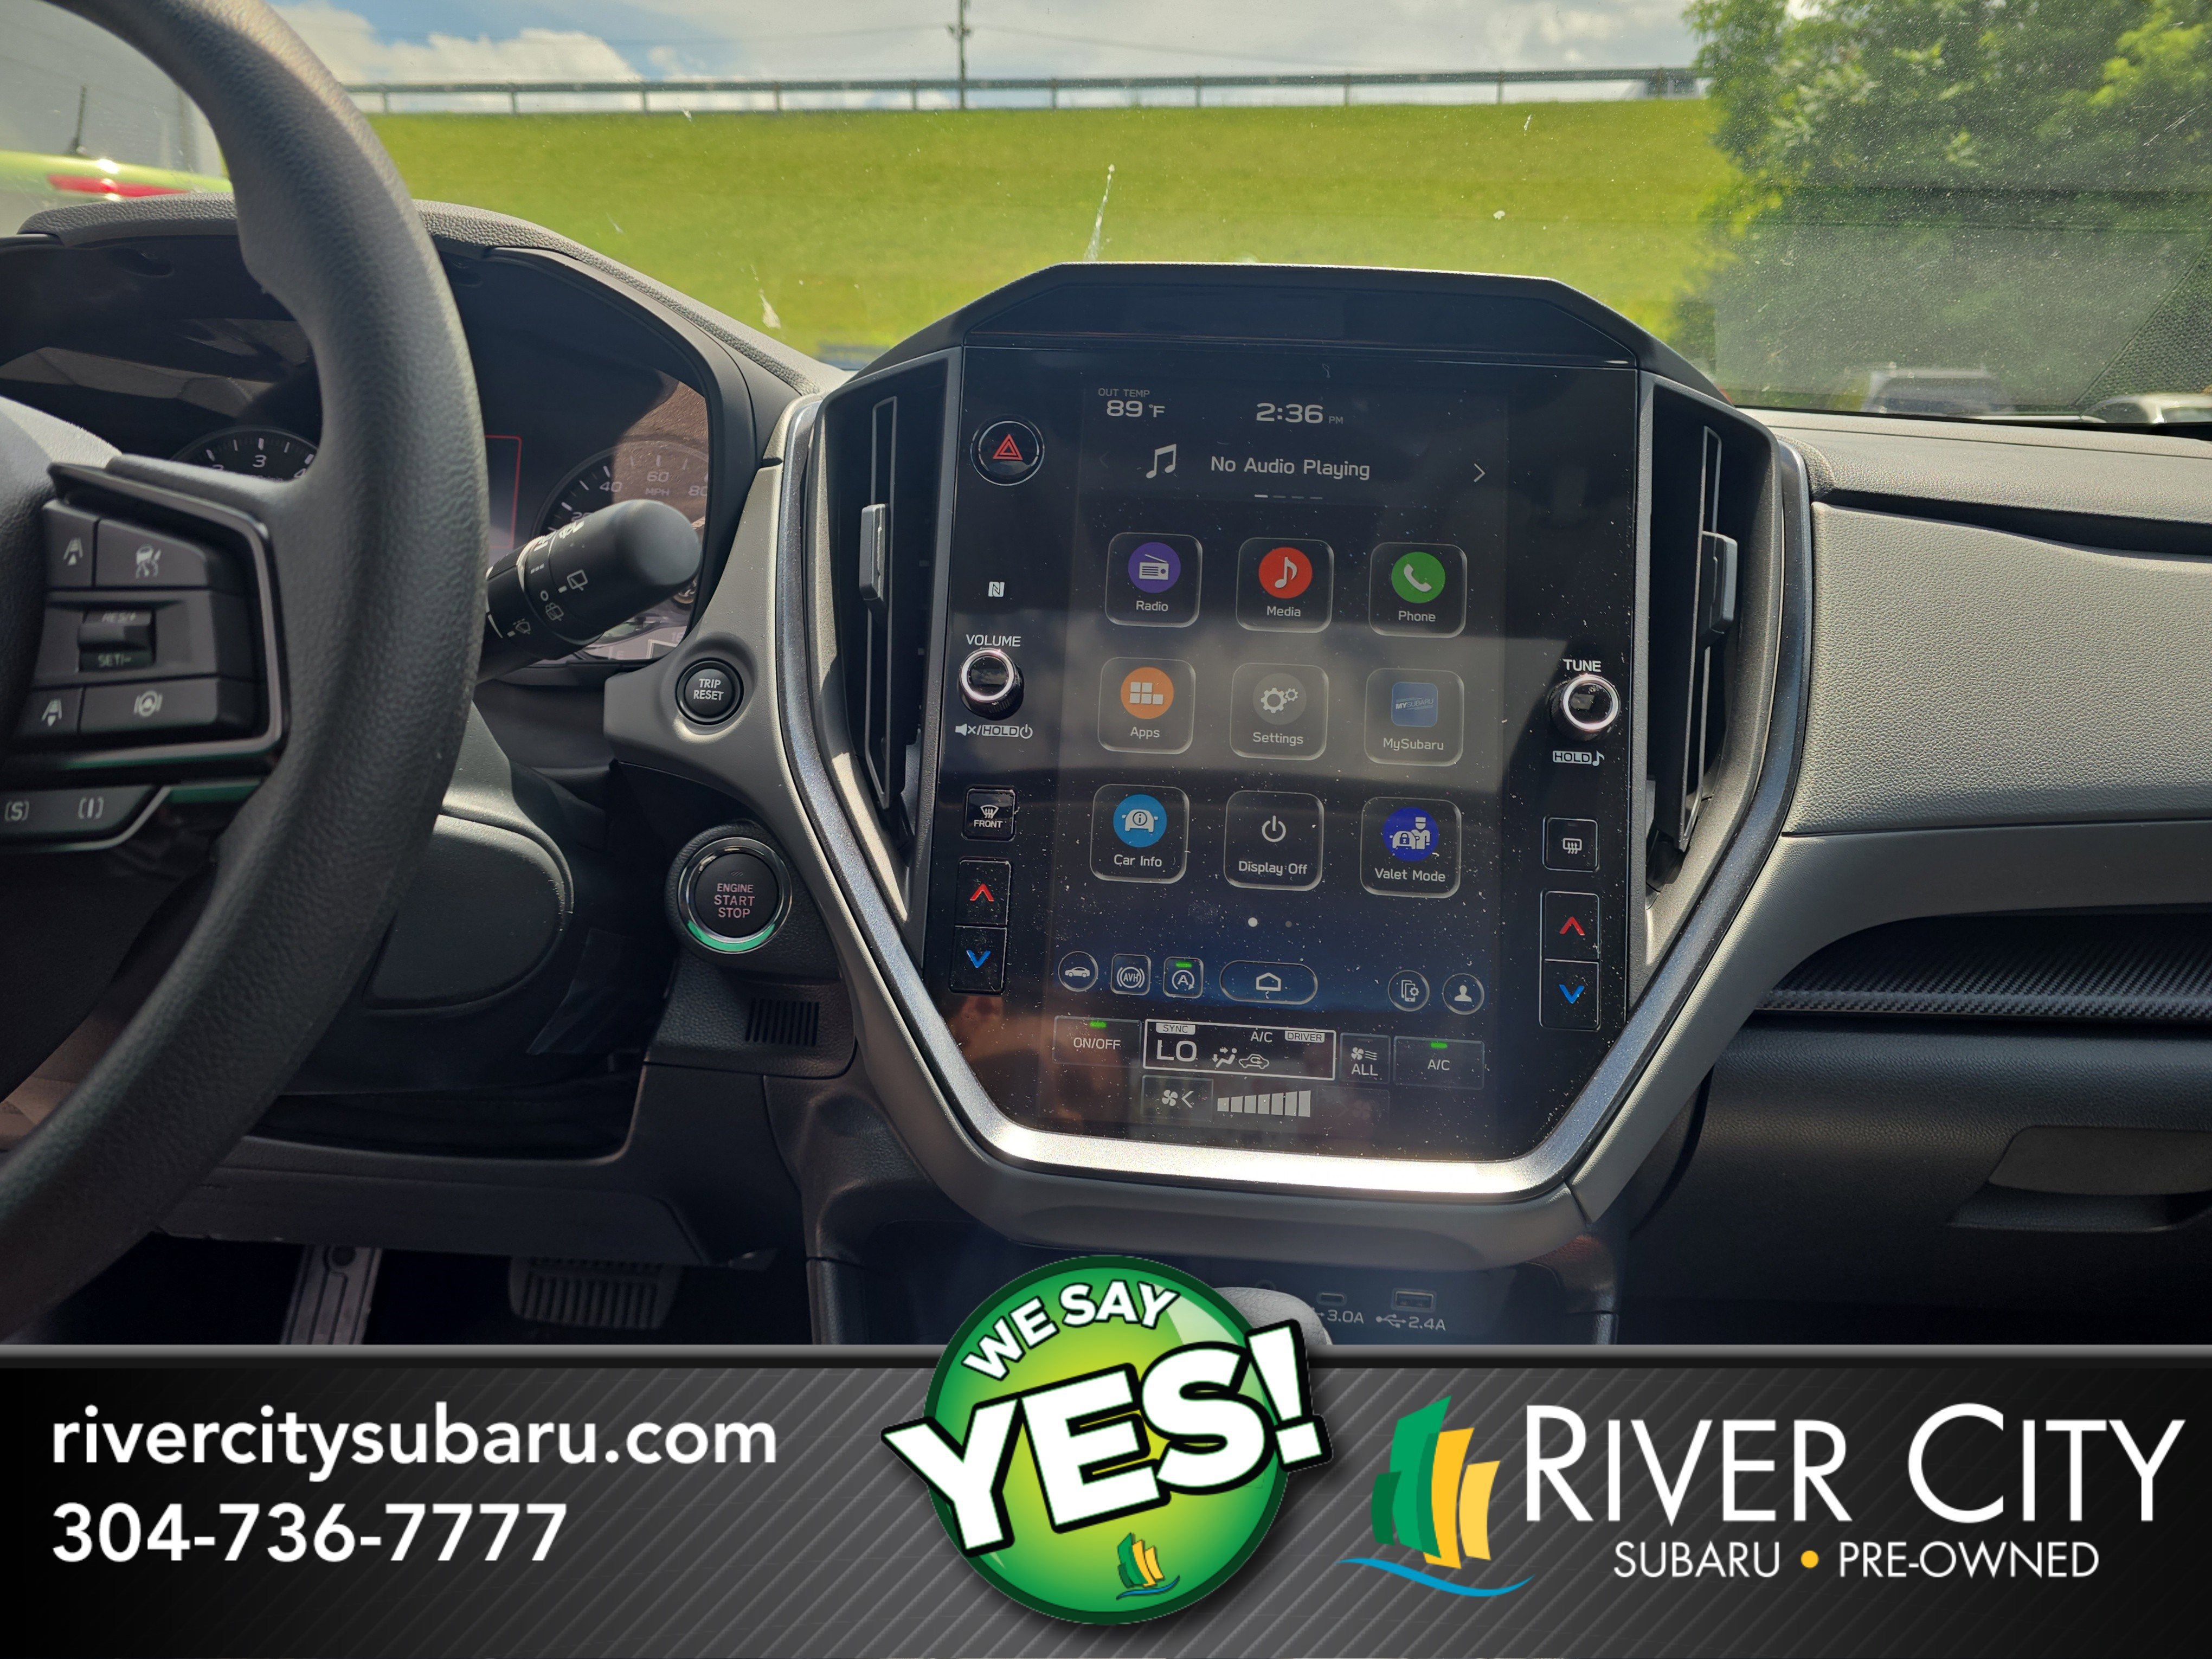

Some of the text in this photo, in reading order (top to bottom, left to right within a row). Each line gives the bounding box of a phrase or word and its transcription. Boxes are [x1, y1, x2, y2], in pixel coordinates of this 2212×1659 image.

[1098, 388, 1150, 397] OUT TEMP
[1107, 400, 1143, 417] 89
[1256, 402, 1343, 425] 2:36 PM
[252, 454, 267, 468] 3
[1211, 456, 1371, 480] No Audio Playing
[647, 471, 670, 483] 60
[600, 481, 623, 493] 40
[645, 488, 670, 496] MPH
[1136, 600, 1169, 613] Radio
[1266, 606, 1301, 618] Media
[1398, 610, 1436, 623] Phone
[966, 634, 1022, 647] VOLUME
[1562, 659, 1602, 672] TUNE
[699, 678, 722, 689] TRIP
[693, 690, 724, 701] RESET
[1130, 726, 1160, 741] Apps
[1252, 732, 1304, 747] Settings
[1383, 738, 1444, 751] MySubaru
[1554, 752, 1590, 763] HOLD
[973, 820, 1003, 828] FRONT
[1114, 854, 1162, 867] Car Info
[1238, 860, 1308, 876] Display Off
[1375, 868, 1446, 883] Valet Mode
[717, 883, 754, 893] ENGINE
[714, 895, 755, 906] START
[718, 907, 750, 918] STOP
[1123, 974, 1139, 982] AVH
[1162, 1025, 1188, 1033] SYNC
[1073, 1037, 1121, 1050] ON/OFF
[1250, 1031, 1273, 1043] A/C
[1287, 1032, 1322, 1042] DRIVER
[1156, 1039, 1197, 1062] LO
[1351, 1063, 1379, 1077] ALL
[1427, 1059, 1450, 1071] A/C
[1327, 1309, 1364, 1324] 3.0A
[1408, 1316, 1446, 1331] 2.4A
